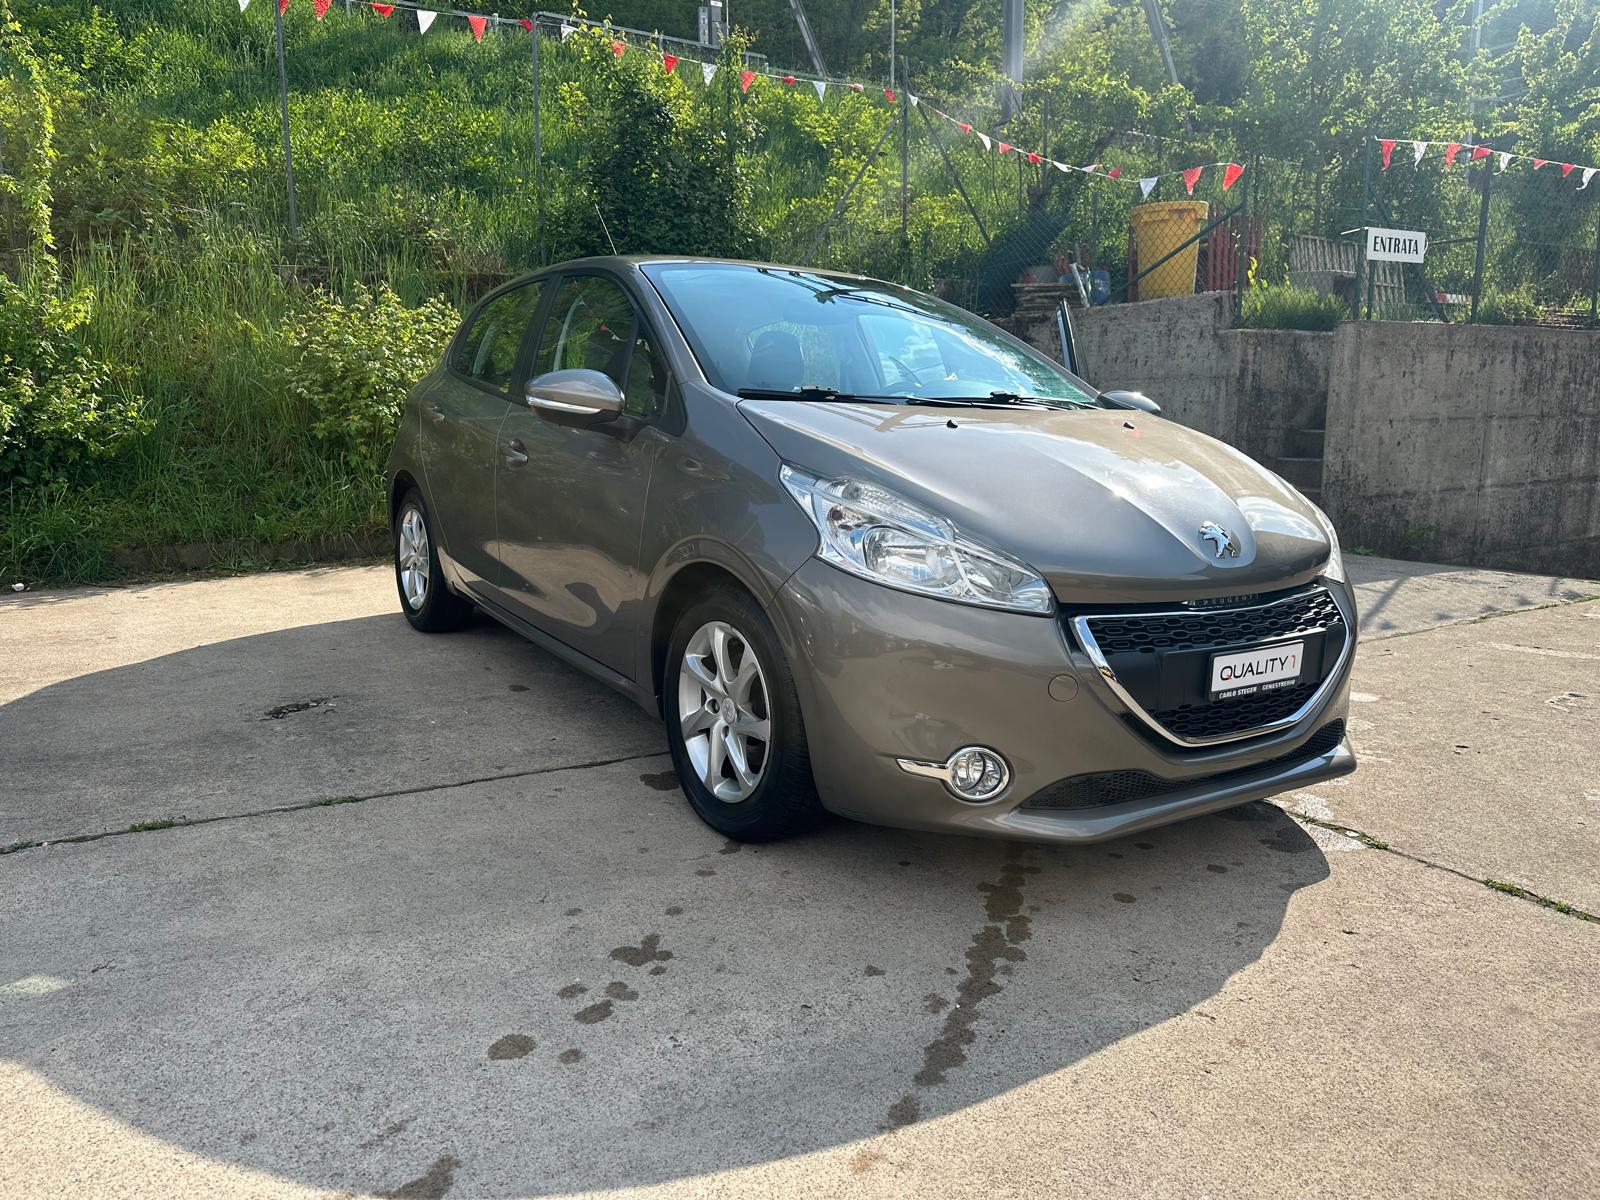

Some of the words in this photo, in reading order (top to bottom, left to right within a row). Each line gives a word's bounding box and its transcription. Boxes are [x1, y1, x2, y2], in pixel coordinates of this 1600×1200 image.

[1373, 236, 1418, 255] ENTRATA
[1220, 656, 1289, 681] QUALITY
[1219, 690, 1237, 699] CARLO
